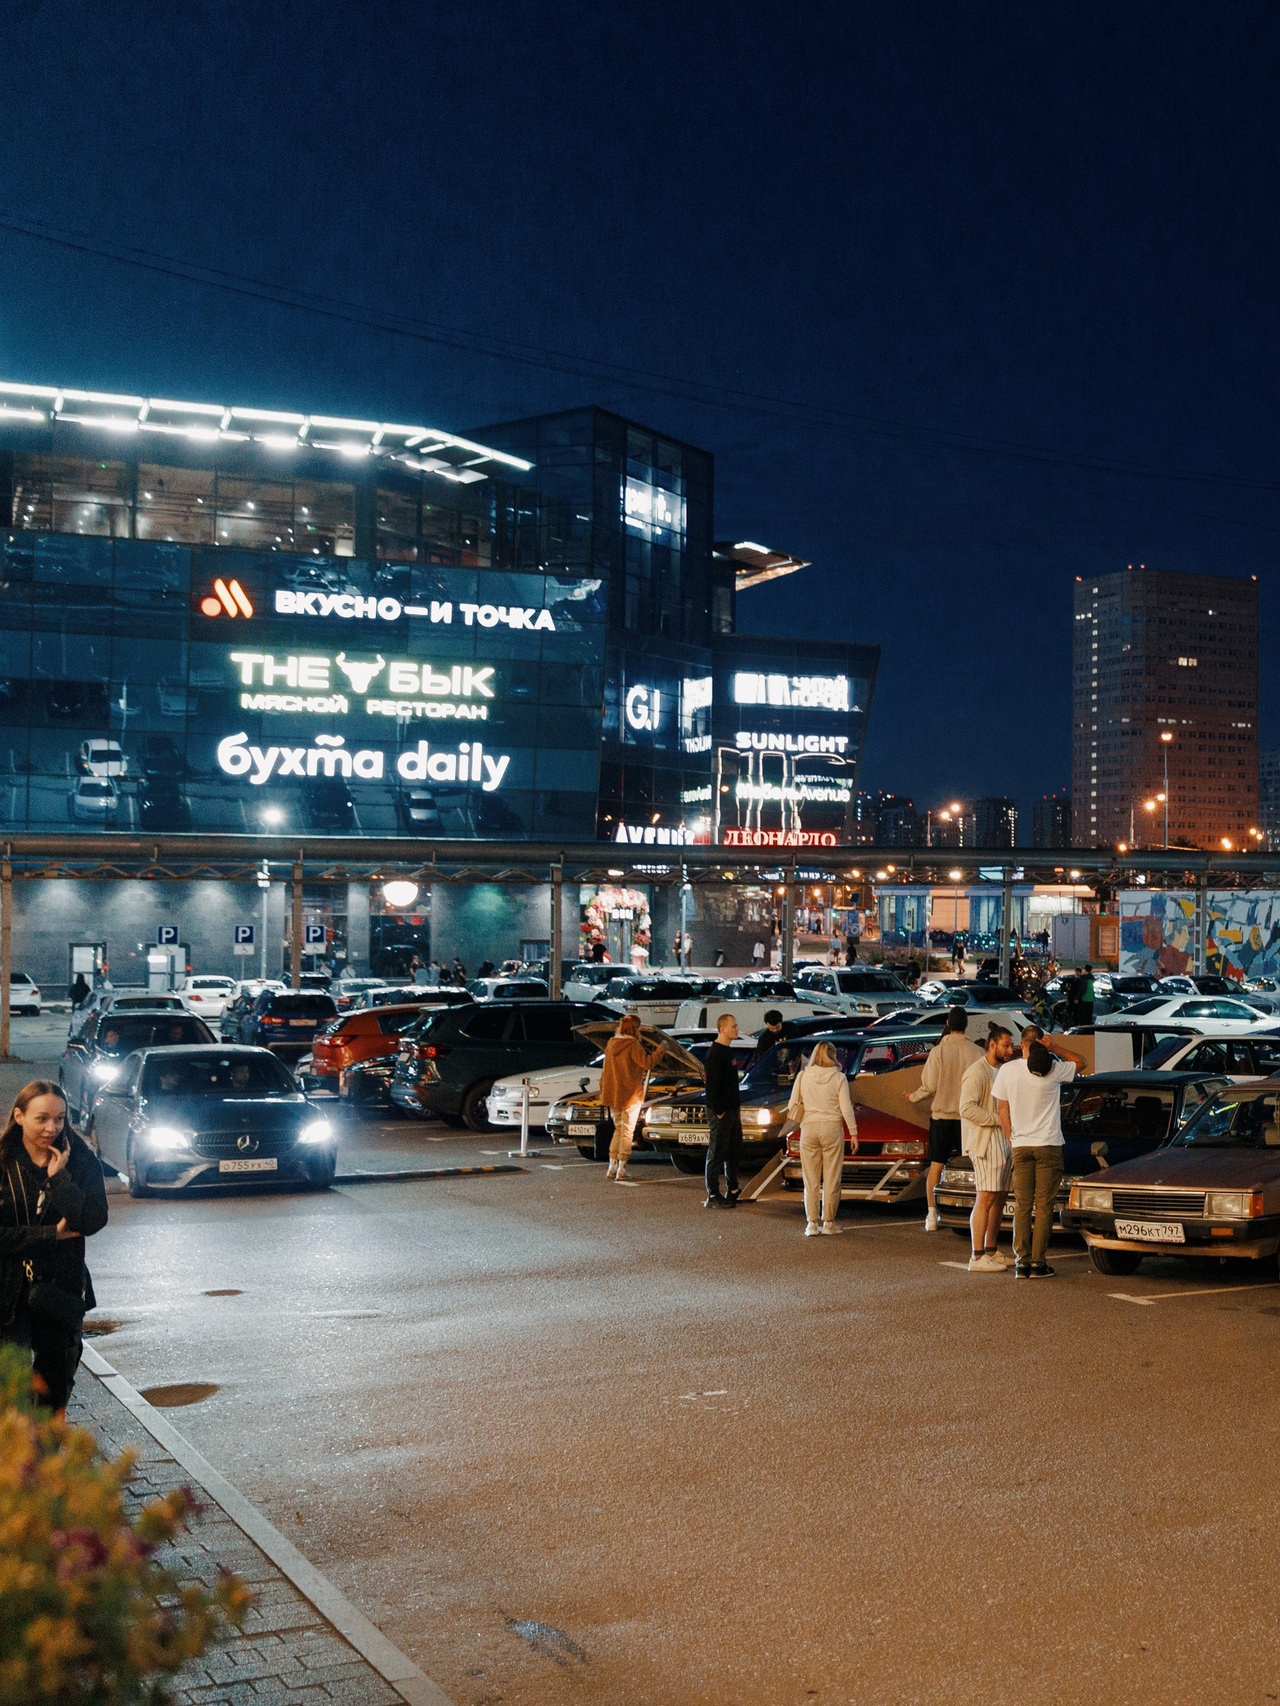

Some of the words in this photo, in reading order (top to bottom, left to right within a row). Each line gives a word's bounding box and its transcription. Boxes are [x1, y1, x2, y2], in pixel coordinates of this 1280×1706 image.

[459, 604, 556, 631] ТОЧКА
[230, 653, 330, 689] THE
[389, 662, 495, 697] БЫК
[241, 693, 348, 713] МЯСНОЙ
[366, 700, 488, 720] РЕСТОРАН
[736, 731, 849, 753] SUNLIGHT
[397, 740, 511, 792] daily
[161, 927, 175, 943] P
[237, 926, 251, 943] P
[308, 926, 322, 942] P
[1118, 1223, 1161, 1238] М296КТ
[1162, 1225, 1180, 1236] 797
